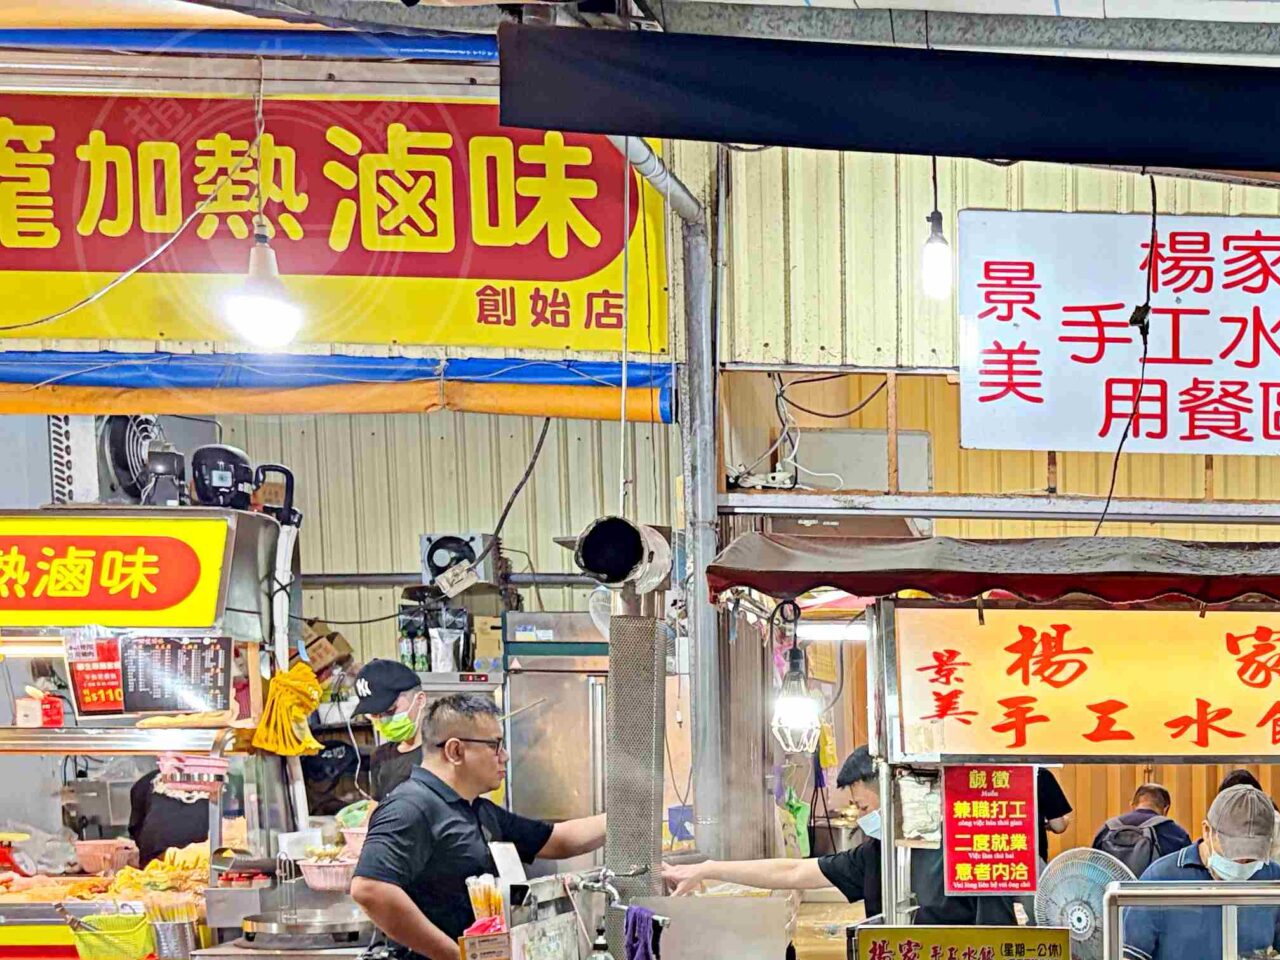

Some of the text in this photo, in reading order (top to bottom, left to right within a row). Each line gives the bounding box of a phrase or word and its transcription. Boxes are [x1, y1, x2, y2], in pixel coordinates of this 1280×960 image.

[474, 284, 626, 329] 創始店
[977, 260, 1045, 404] 景美
[916, 649, 979, 726] 景美
[953, 800, 1027, 818] 兼職打工
[954, 833, 1028, 851] 二度就業
[955, 862, 1029, 881] 意者內洽
[1000, 943, 1062, 957] (星期一公休)
